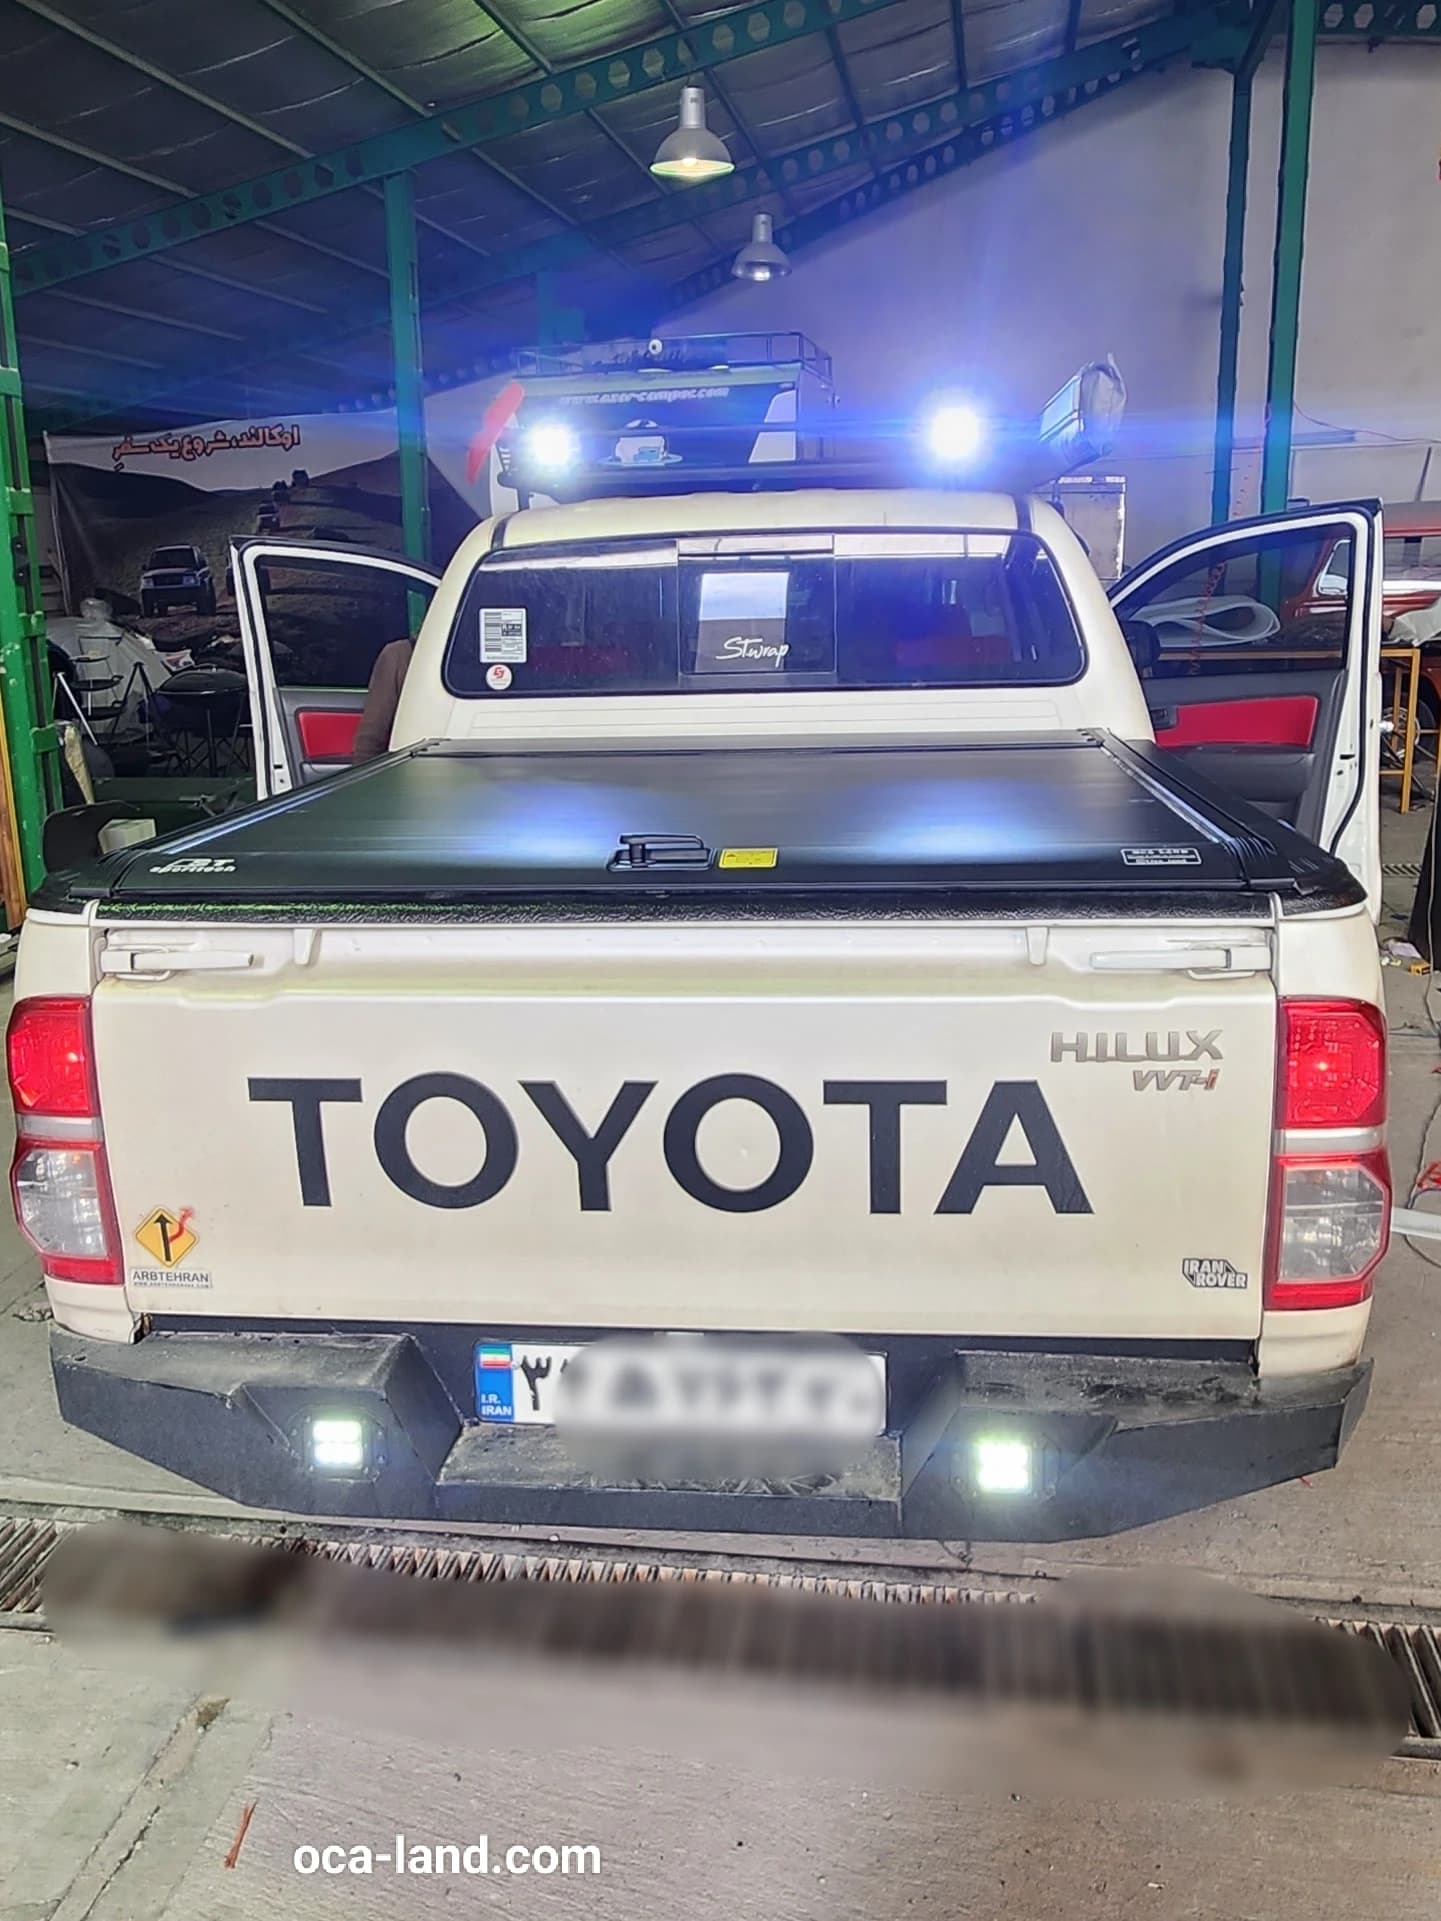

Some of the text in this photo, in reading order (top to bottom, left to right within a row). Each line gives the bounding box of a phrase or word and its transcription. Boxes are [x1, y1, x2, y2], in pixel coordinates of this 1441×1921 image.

[1050, 1030, 1223, 1063] HILUX
[247, 1071, 1096, 1215] TOYOTA
[1183, 1259, 1225, 1275] IRAN
[132, 1271, 209, 1282] ARBTEHRAN
[1194, 1273, 1247, 1288] ROVER
[480, 1393, 501, 1404] I.R.
[481, 1405, 512, 1416] IRAN
